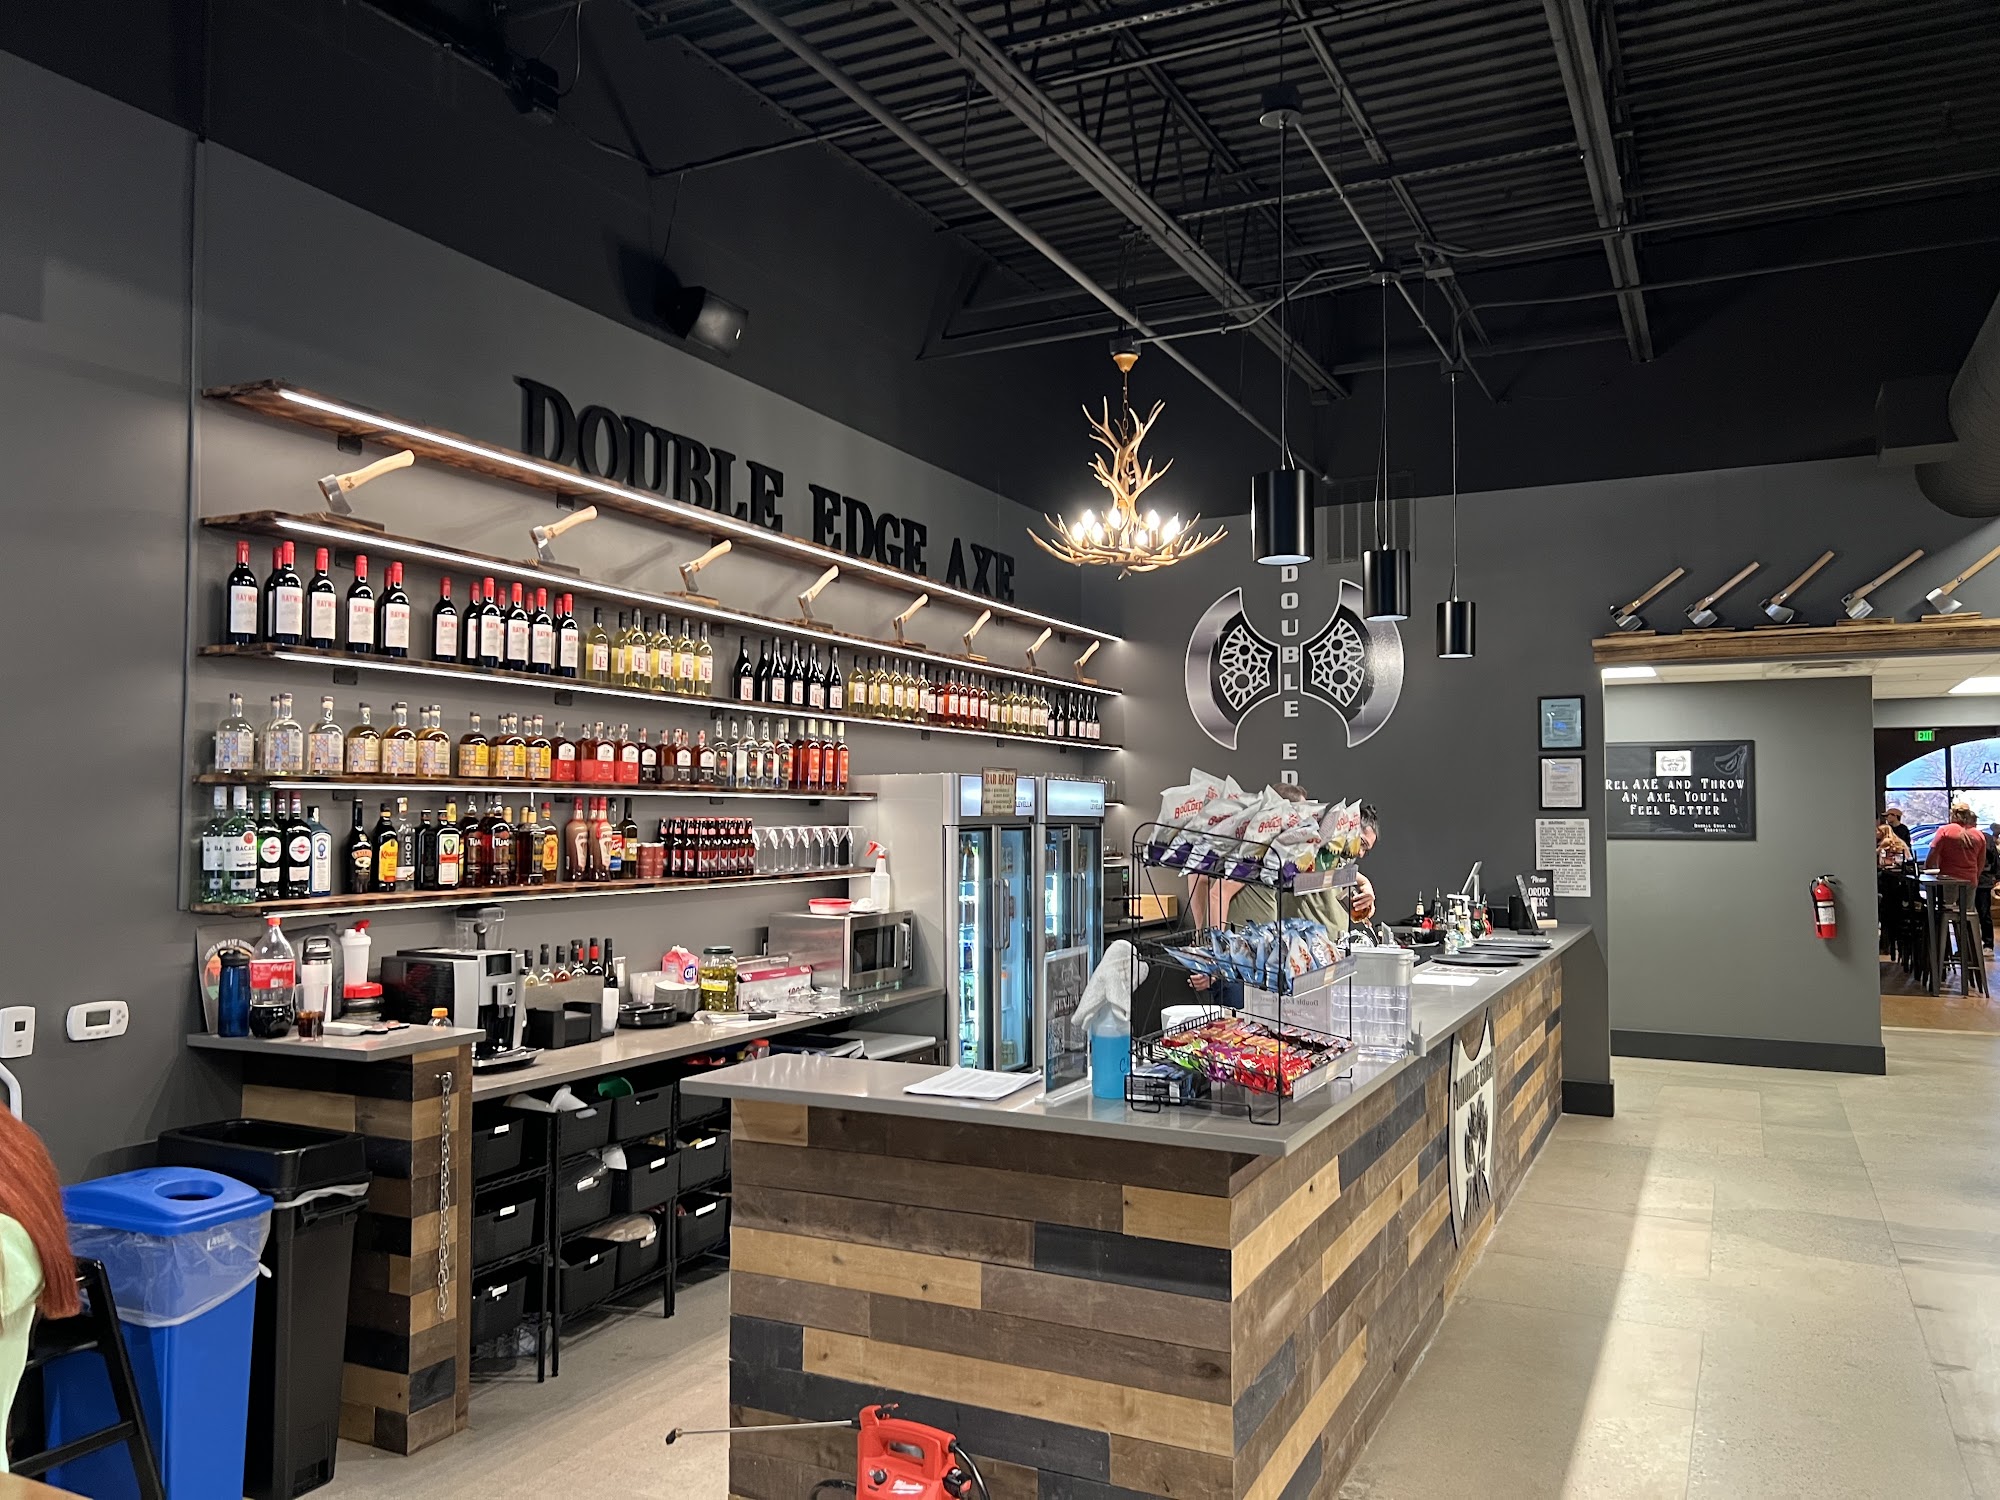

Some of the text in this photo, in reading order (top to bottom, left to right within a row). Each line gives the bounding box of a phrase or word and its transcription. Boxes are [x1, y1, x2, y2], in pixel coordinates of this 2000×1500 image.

[512, 374, 1015, 604] DOUBLE EDGE AXE
[1280, 564, 1300, 718] DOUBLE
[985, 773, 997, 785] BAR
[1668, 780, 1691, 790] AND
[1701, 778, 1744, 790] THROW
[1622, 791, 1728, 803] AN AXE. YOU'LL
[1630, 804, 1720, 816] FEEL BETTER
[1528, 887, 1550, 897] ORDER
[1531, 897, 1548, 907] ERE
